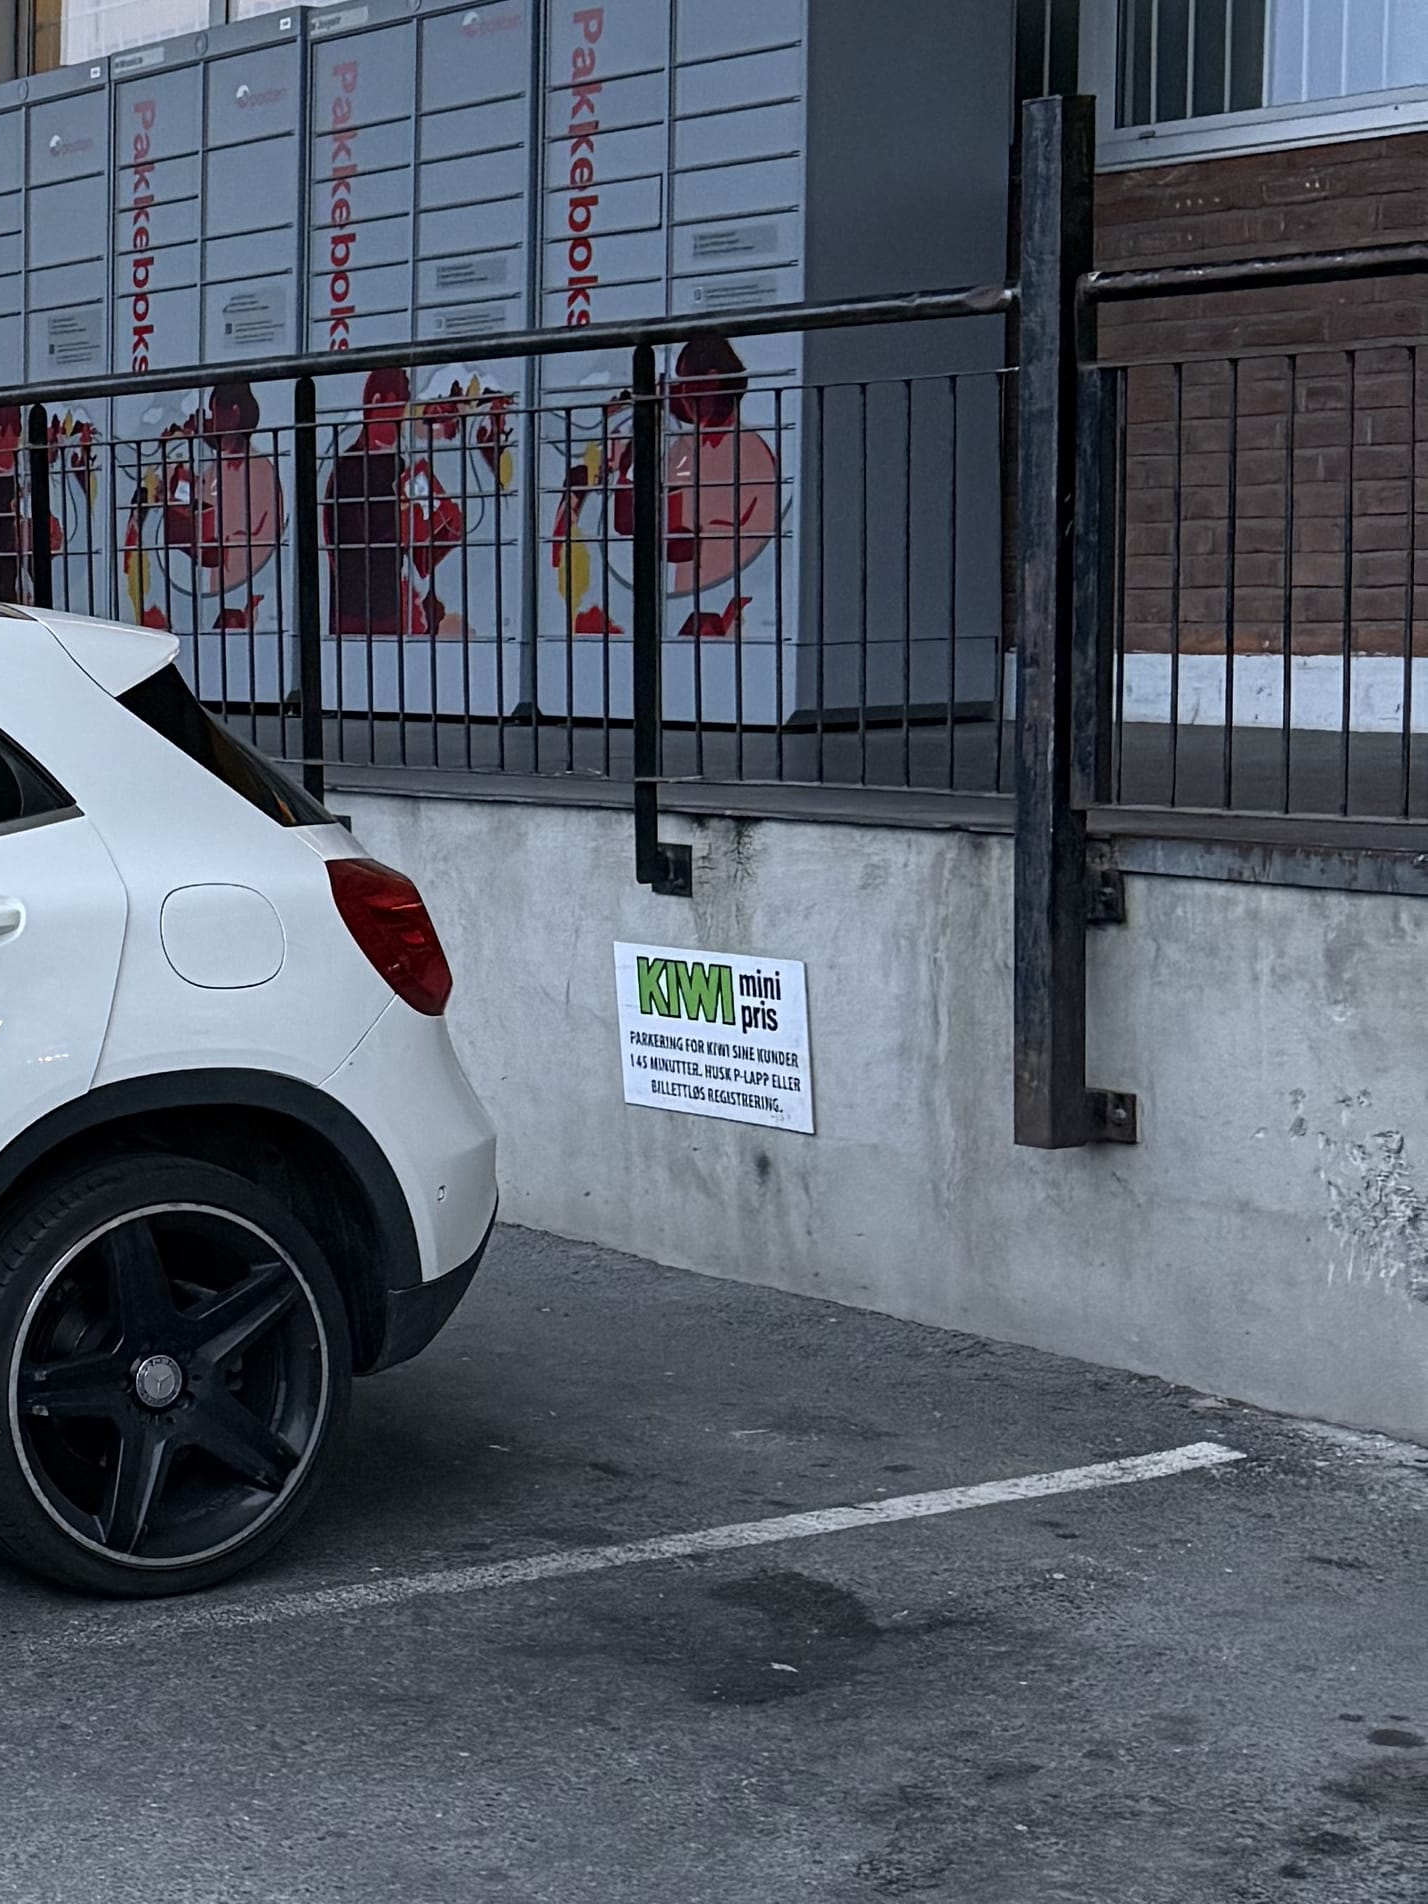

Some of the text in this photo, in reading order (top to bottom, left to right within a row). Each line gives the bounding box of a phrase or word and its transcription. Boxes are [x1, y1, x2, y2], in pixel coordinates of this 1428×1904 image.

[567, 7, 604, 329] Pakkeboks
[132, 100, 156, 376] Pakkeboks
[636, 956, 782, 1026] KIWI mini
[741, 1000, 779, 1034] pris
[630, 1030, 799, 1069] PARKERING FOR KIWI SINE KUNDER
[636, 1055, 648, 1069] 45
[704, 1063, 732, 1082] HUSK
[733, 1068, 770, 1087] P-LAPP
[771, 1073, 801, 1093] ELLER
[651, 1079, 784, 1113] BILLETTLØS REGISTRERING.
